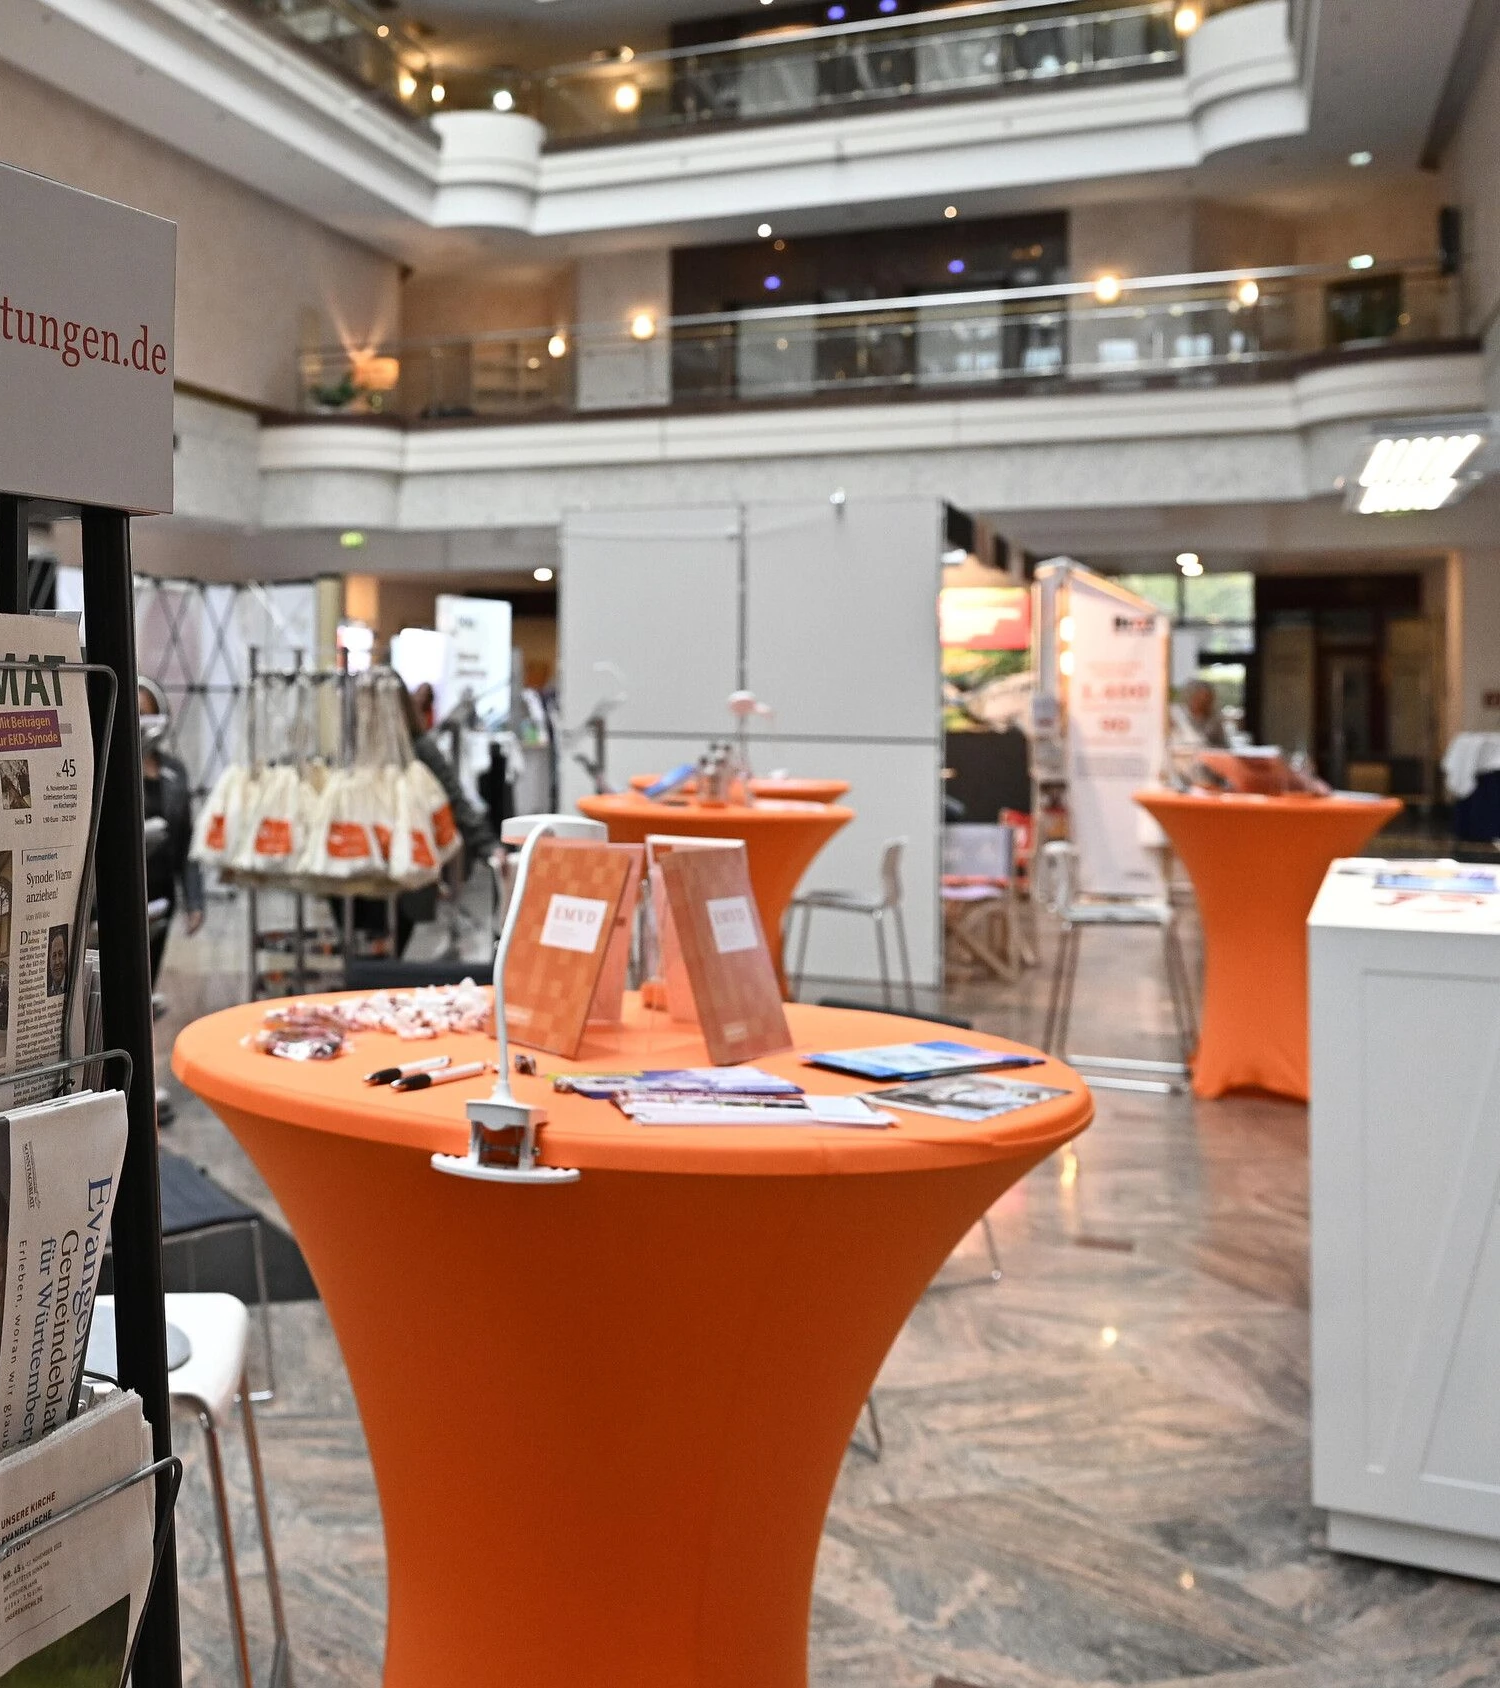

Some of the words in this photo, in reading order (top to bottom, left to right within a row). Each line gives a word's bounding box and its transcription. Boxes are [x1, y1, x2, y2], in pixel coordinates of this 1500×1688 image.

[8, 732, 58, 747] EKD-Synode
[12, 716, 51, 729] Beiträgen
[61, 759, 76, 777] 45
[25, 814, 32, 825] 13
[27, 852, 58, 862] Kommentiert
[26, 870, 54, 887] Synode:
[14, 1240, 27, 1300] Erleben,
[40, 1237, 57, 1274] für
[10, 1316, 21, 1364] woran
[41, 1229, 80, 1435] Gemeindeblat
[19, 1280, 53, 1443] Württember
[8, 1370, 16, 1396] wir
[2, 1404, 12, 1449] glaub
[1, 1507, 30, 1530] UNSERE
[30, 1491, 56, 1514] KIRCHE
[1, 1509, 52, 1545] EVANGELISCHE
